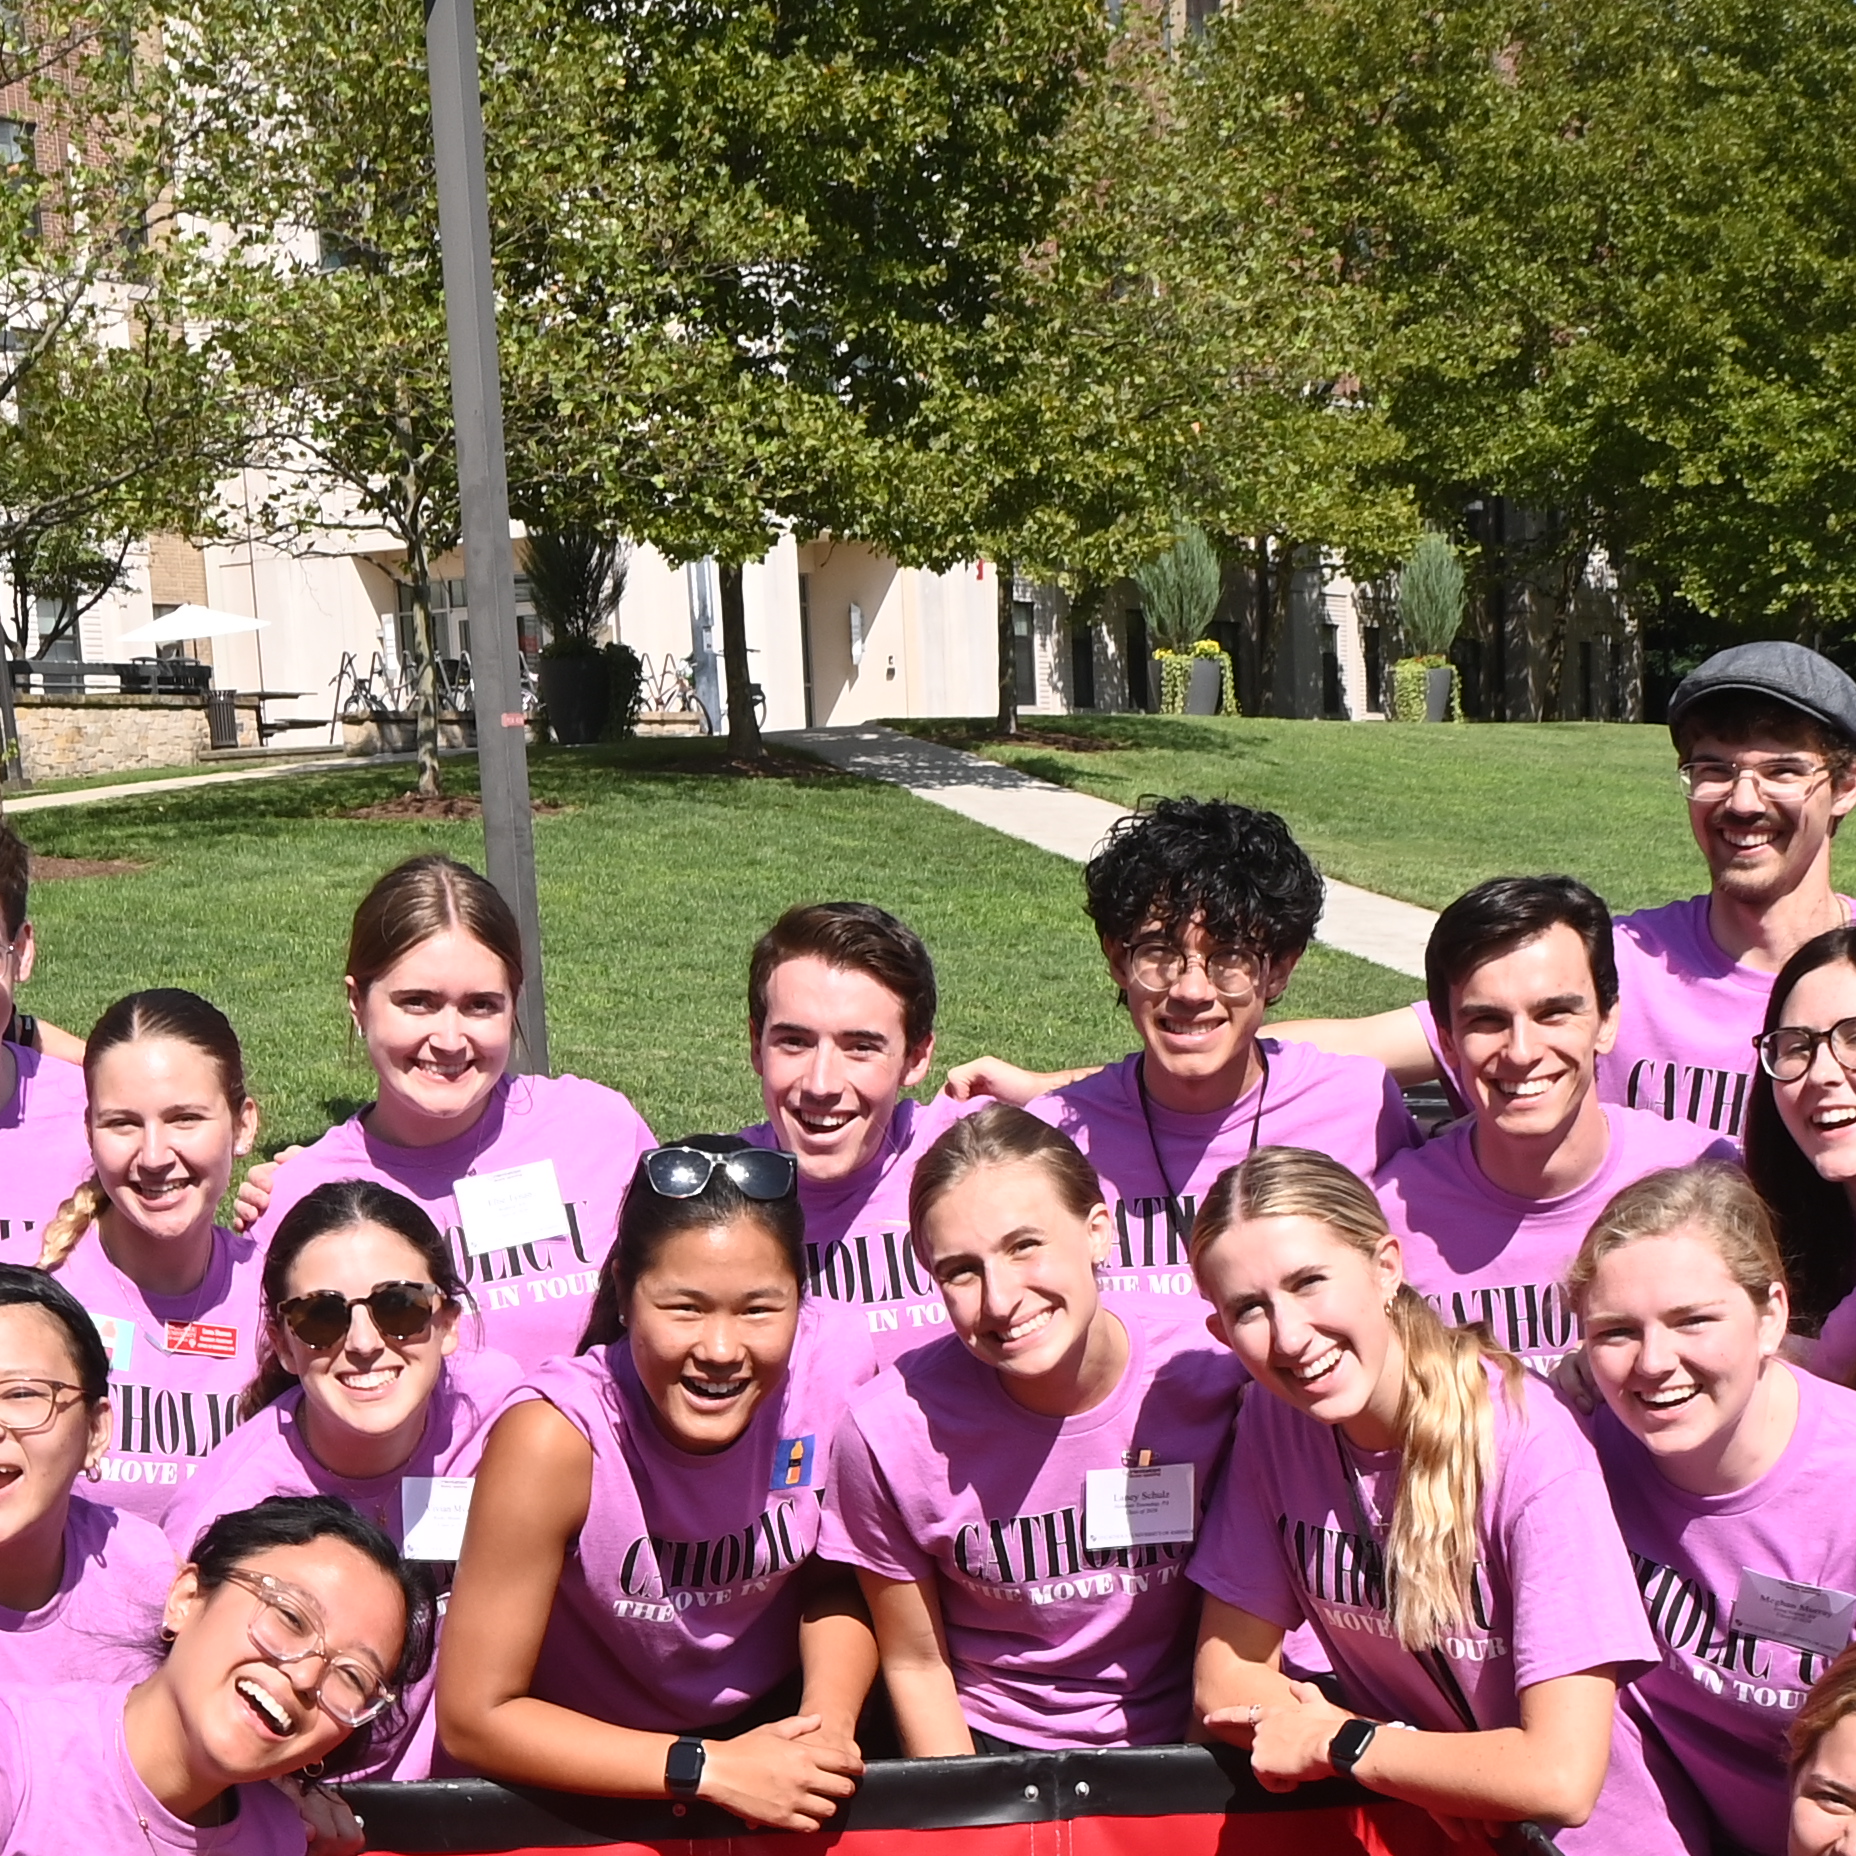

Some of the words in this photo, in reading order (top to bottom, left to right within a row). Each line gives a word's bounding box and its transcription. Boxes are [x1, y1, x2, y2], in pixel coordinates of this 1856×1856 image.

[486, 1283, 521, 1311] IN
[866, 1308, 899, 1333] IN
[108, 1382, 245, 1458] HOLIC
[954, 1507, 1186, 1584] CATH
[613, 1600, 676, 1623] THE
[671, 1588, 733, 1613] OVE
[1028, 1573, 1115, 1606] MOVE
[1119, 1571, 1149, 1597] IN
